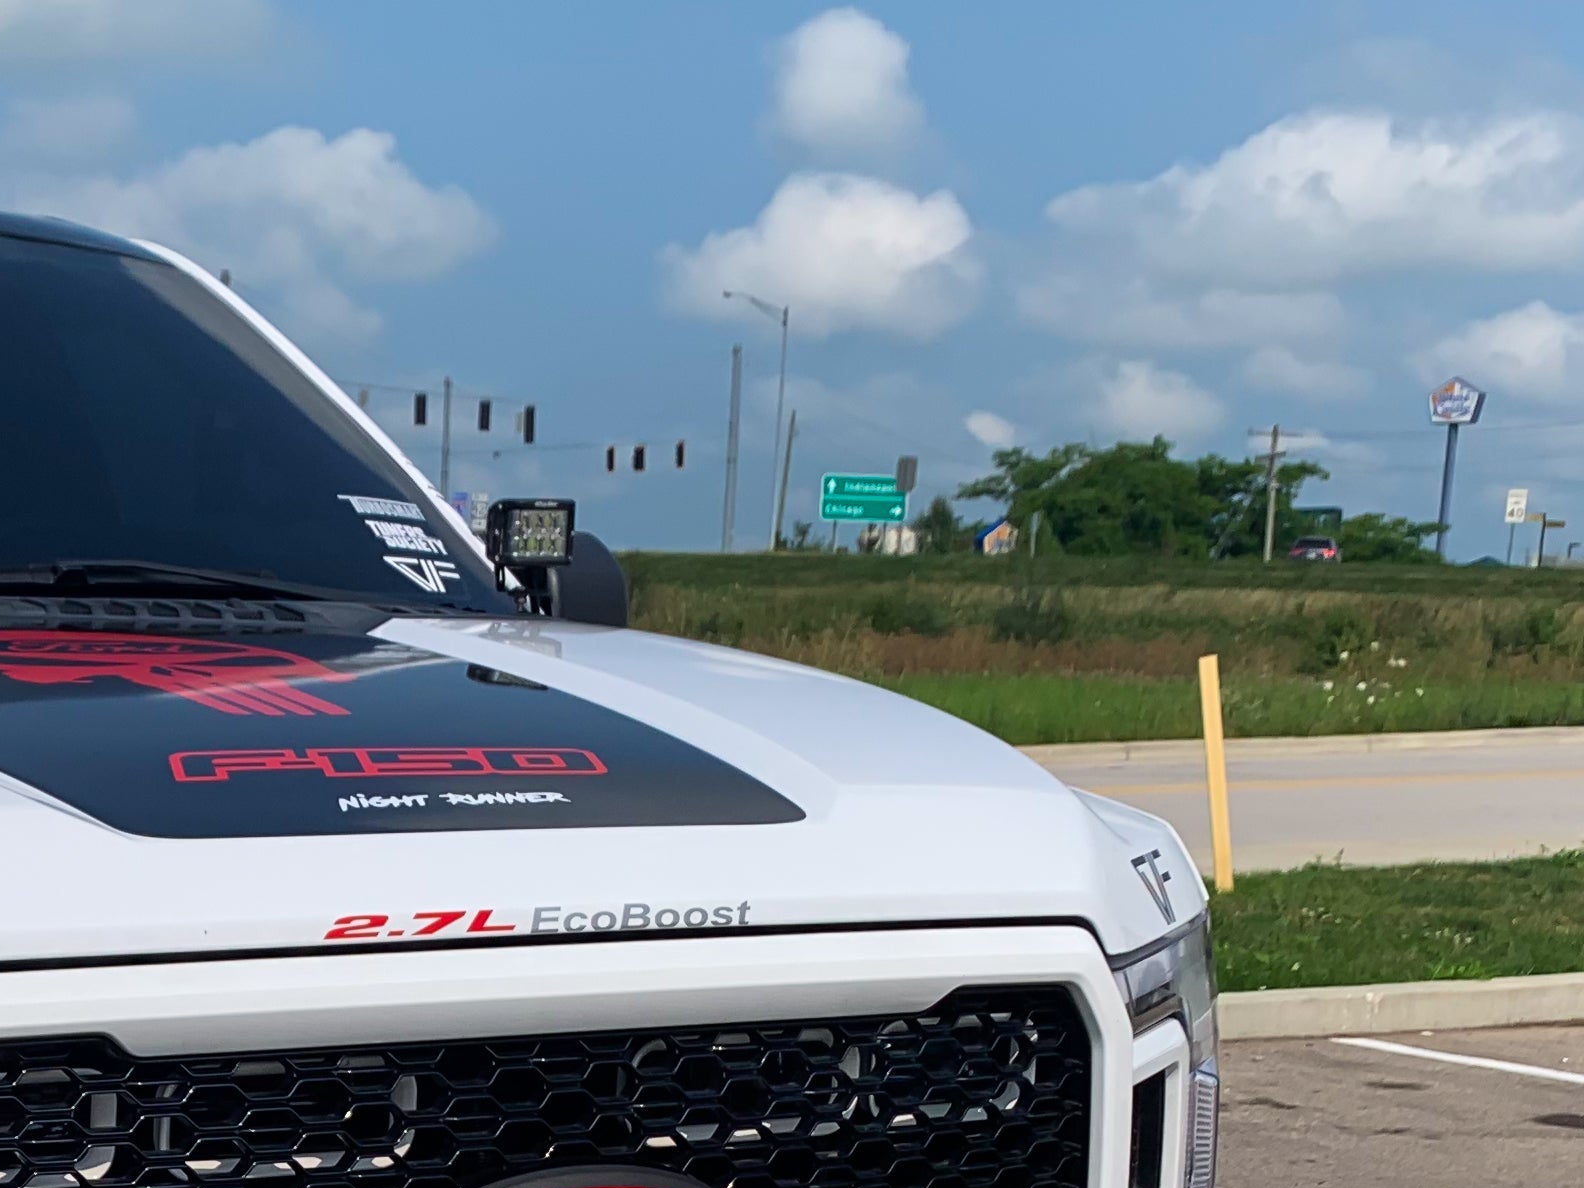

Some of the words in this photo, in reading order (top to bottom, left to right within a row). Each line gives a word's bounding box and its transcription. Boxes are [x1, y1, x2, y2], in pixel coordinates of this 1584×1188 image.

[168, 747, 608, 782] F-150
[438, 791, 572, 805] RUNNER
[323, 909, 516, 940] 2.7L
[529, 900, 752, 935] EcoBoost
